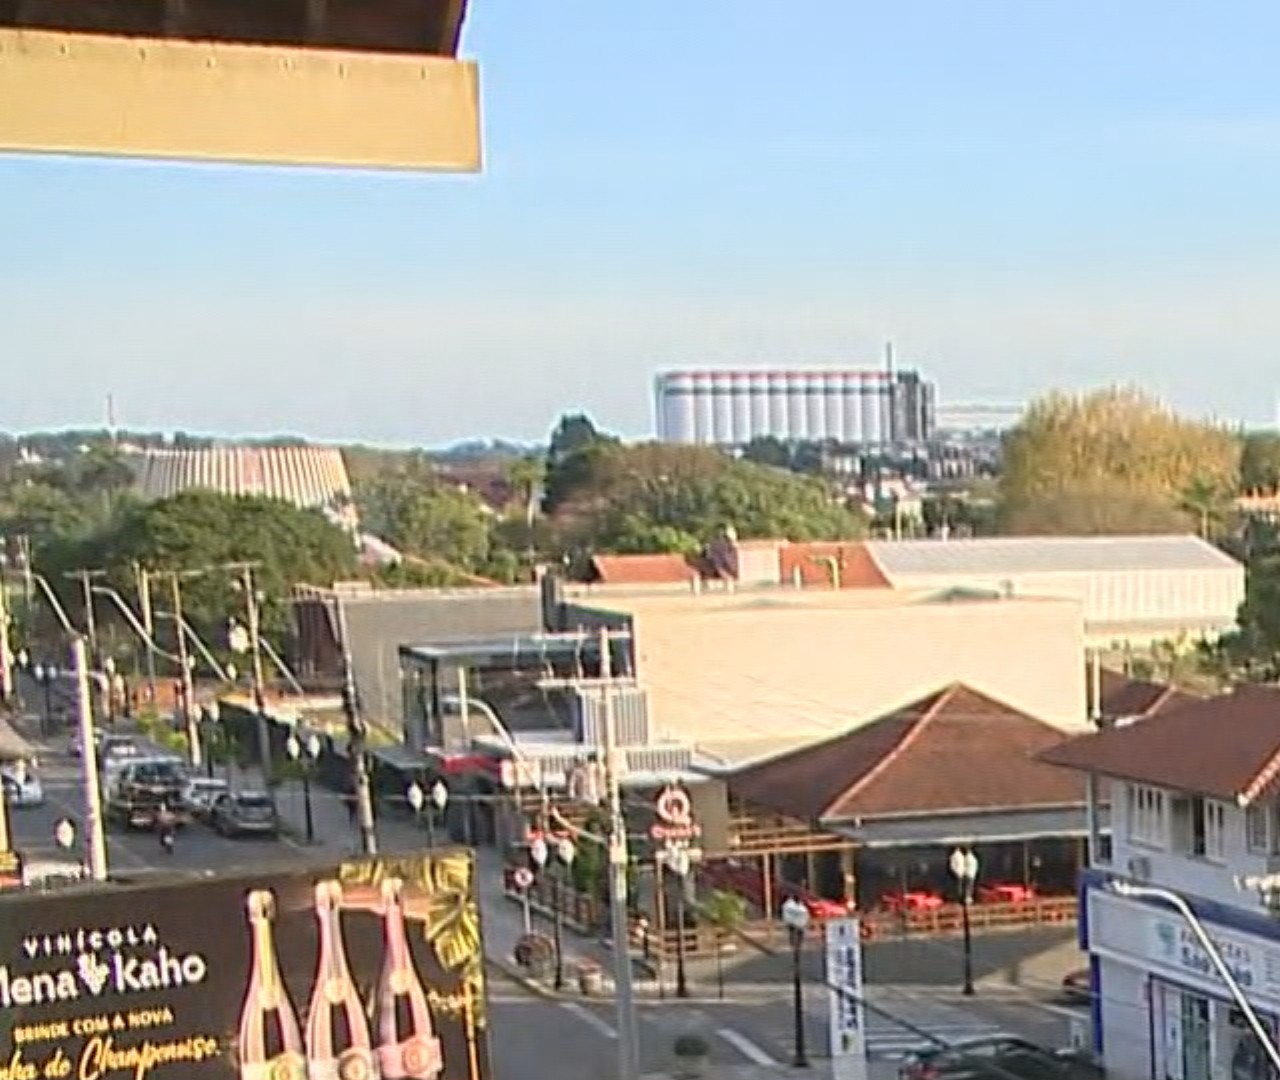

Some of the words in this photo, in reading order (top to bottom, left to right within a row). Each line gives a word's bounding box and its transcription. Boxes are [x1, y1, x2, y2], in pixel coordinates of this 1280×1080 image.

[23, 924, 158, 959] VINÍCOLA
[73, 1016, 109, 1036] COM
[113, 1012, 126, 1030] A
[129, 1006, 174, 1029] NOVA
